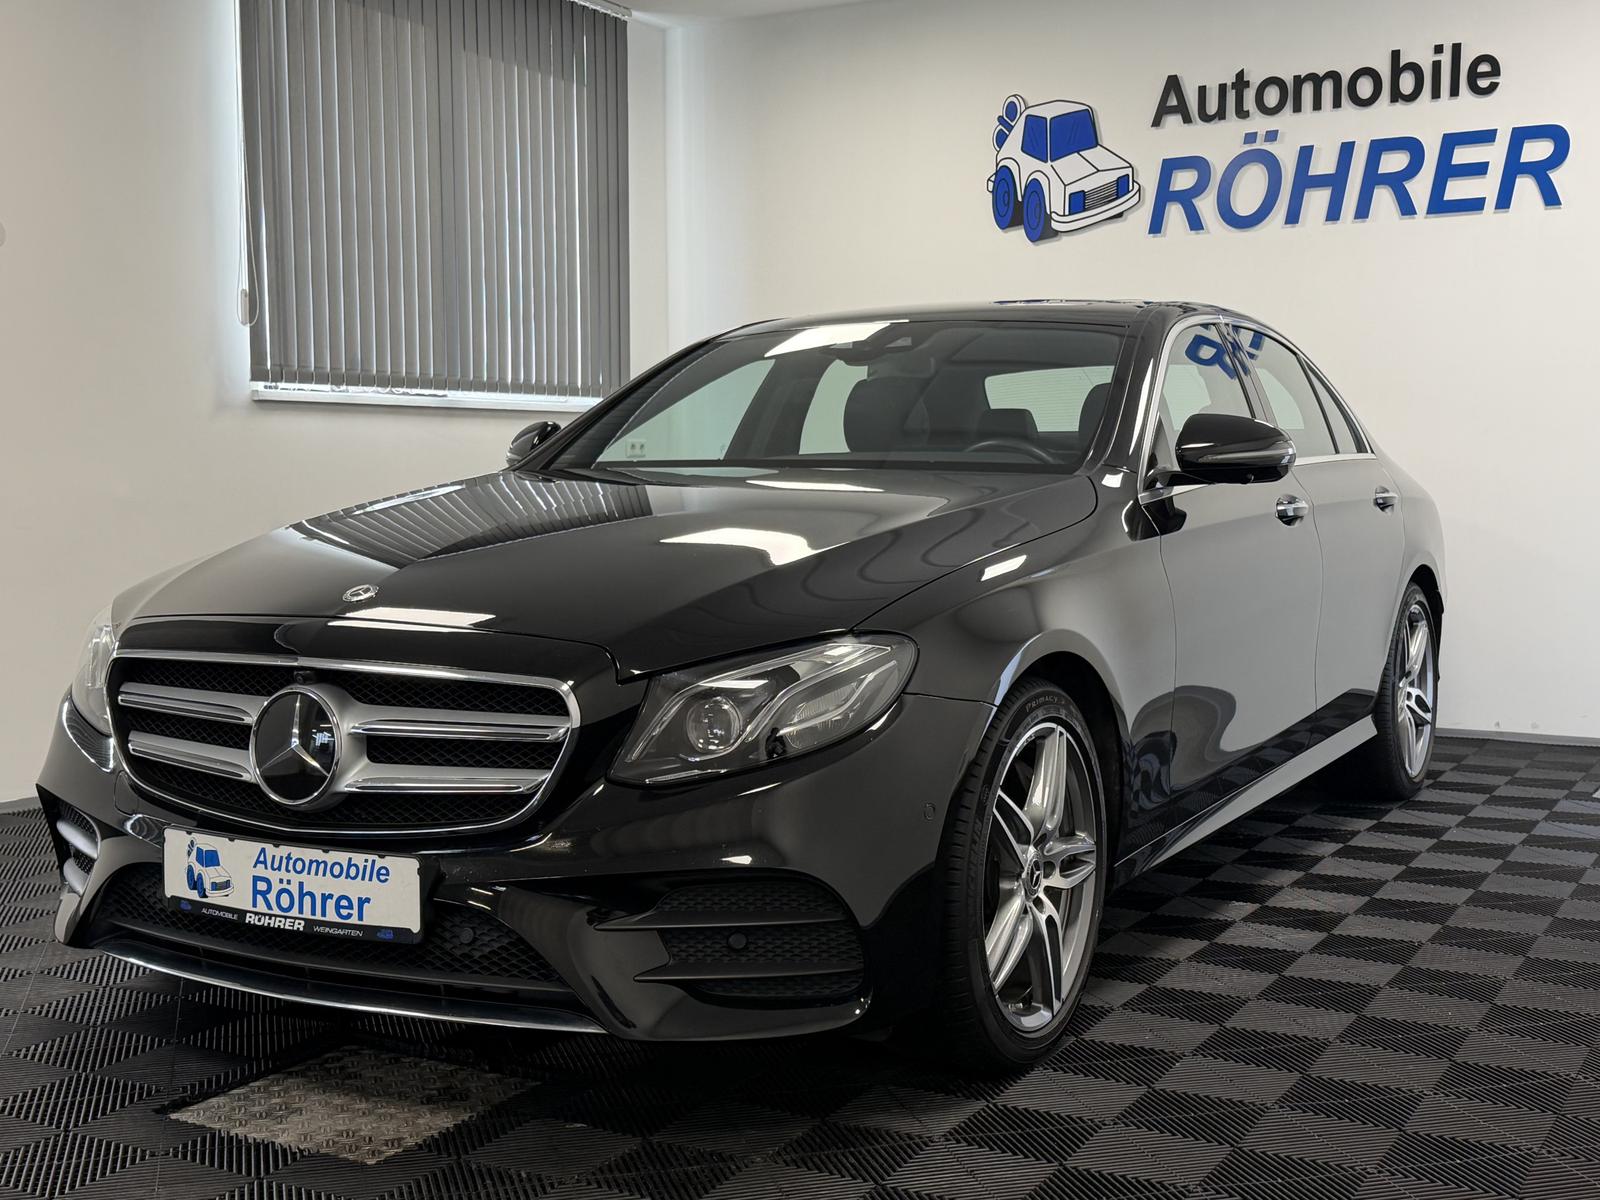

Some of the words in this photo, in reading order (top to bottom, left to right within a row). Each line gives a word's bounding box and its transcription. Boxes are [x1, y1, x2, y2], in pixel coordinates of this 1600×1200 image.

[1150, 42, 1501, 128] Automobile
[1147, 123, 1571, 236] RÖHRER
[1025, 695, 1058, 713] PRIMACY
[253, 847, 390, 883] Automobile
[252, 875, 371, 922] Röhrer
[201, 907, 238, 921] AUTOMOBILE
[245, 912, 305, 931] RÖHRER
[313, 925, 364, 937] WEINGARTEN
